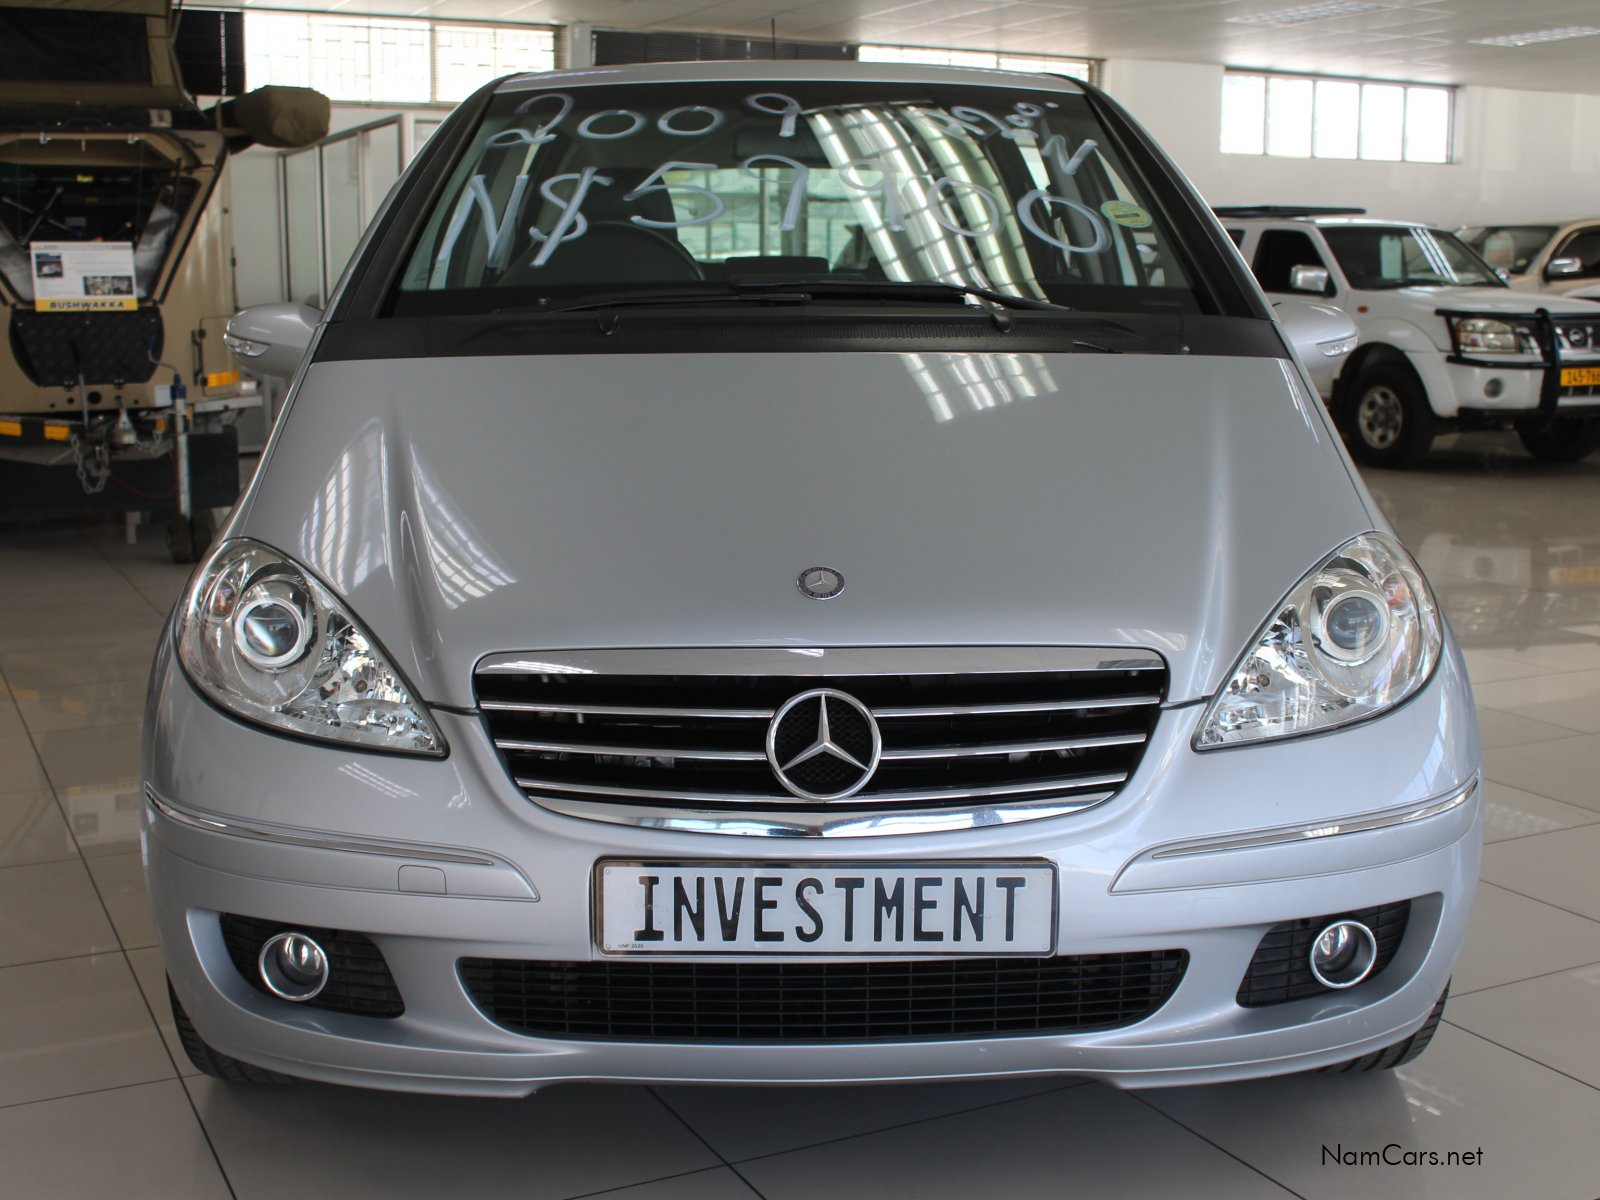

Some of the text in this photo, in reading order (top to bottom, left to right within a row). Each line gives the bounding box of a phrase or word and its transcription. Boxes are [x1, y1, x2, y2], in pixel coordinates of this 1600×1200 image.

[483, 93, 804, 148] 2009
[50, 301, 125, 309] BUSHWAKKA
[633, 876, 1027, 943] INVESTMENT
